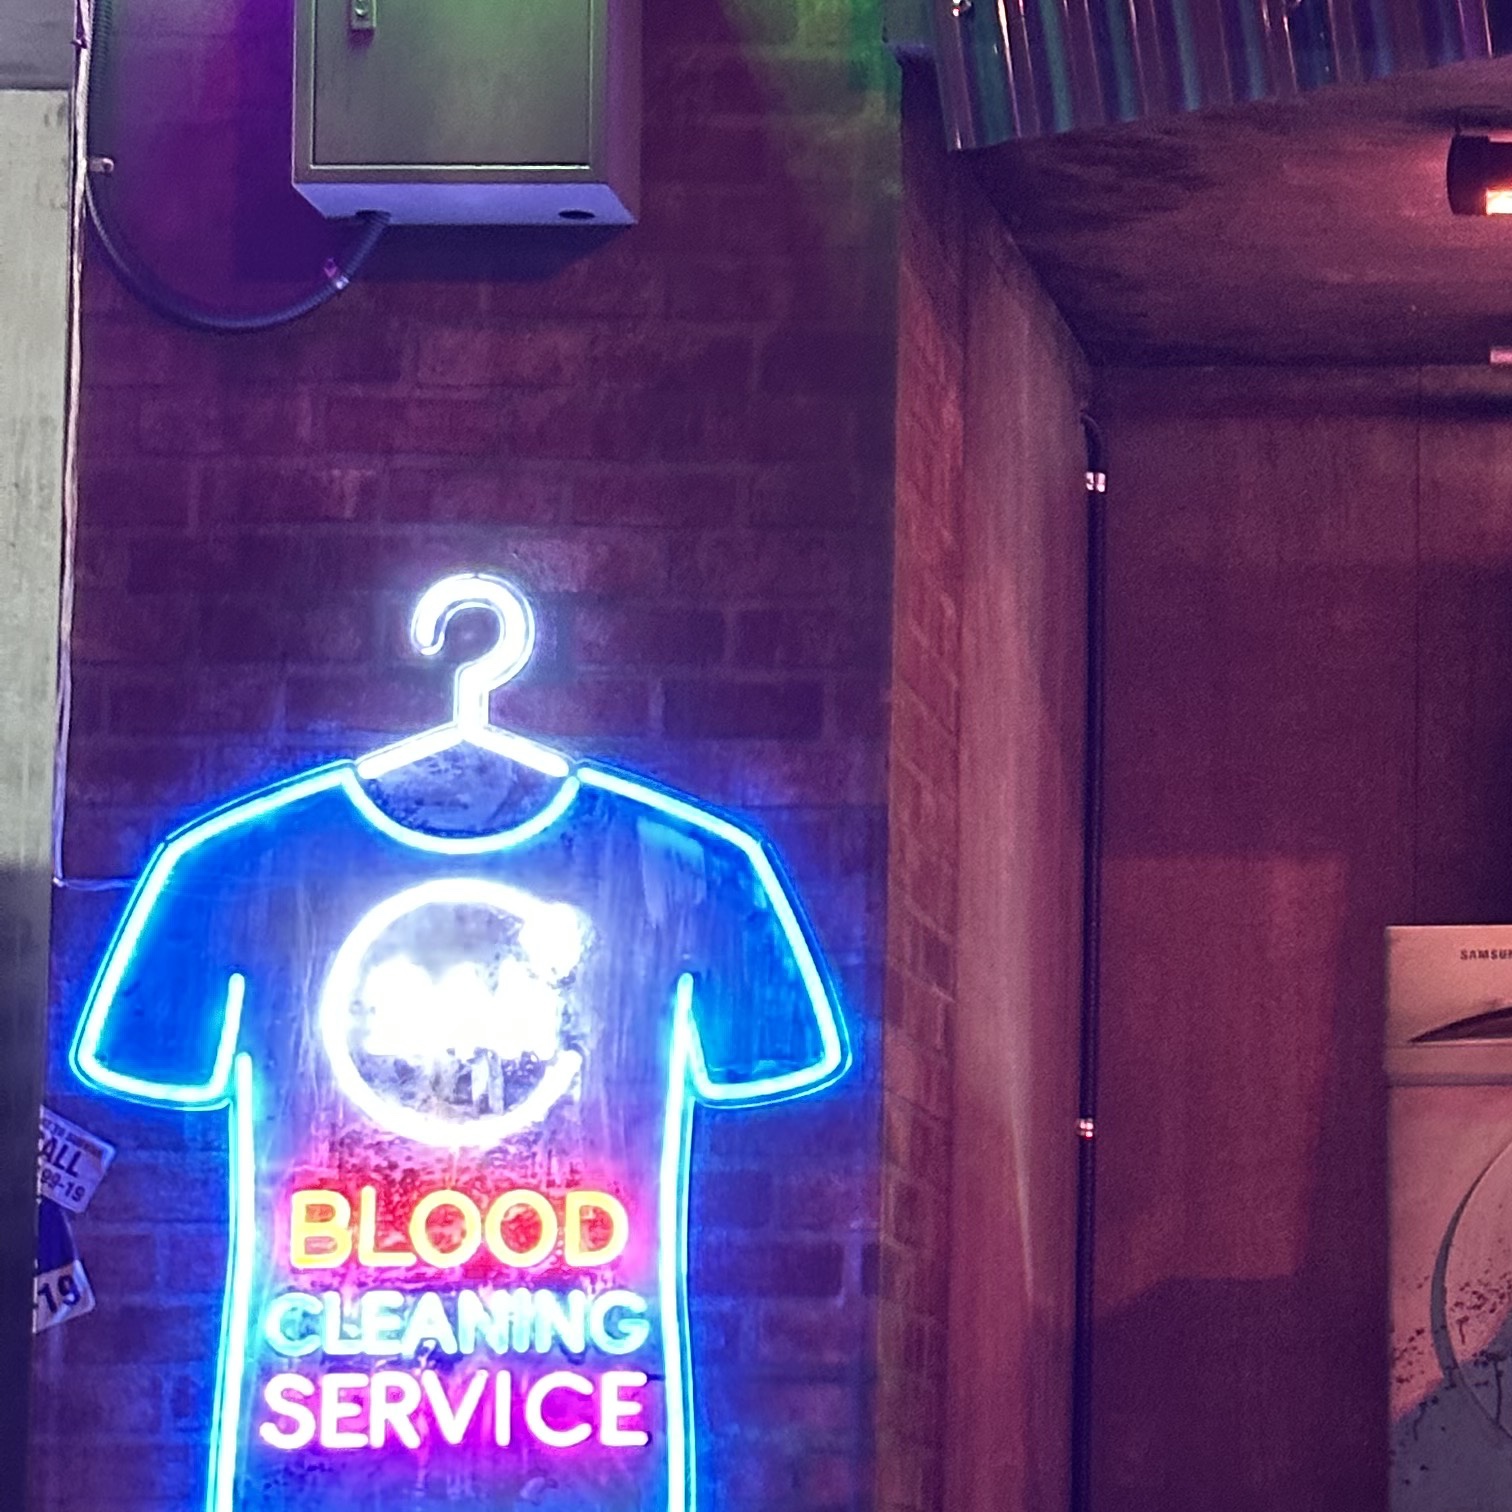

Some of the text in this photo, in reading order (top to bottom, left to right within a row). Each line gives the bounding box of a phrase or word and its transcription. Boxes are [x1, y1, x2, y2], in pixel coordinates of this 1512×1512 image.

[41, 1136, 81, 1178] ALL
[289, 1186, 629, 1269] BLOOD
[265, 1288, 651, 1357] CLEANING
[259, 1368, 650, 1450] SERVICE
